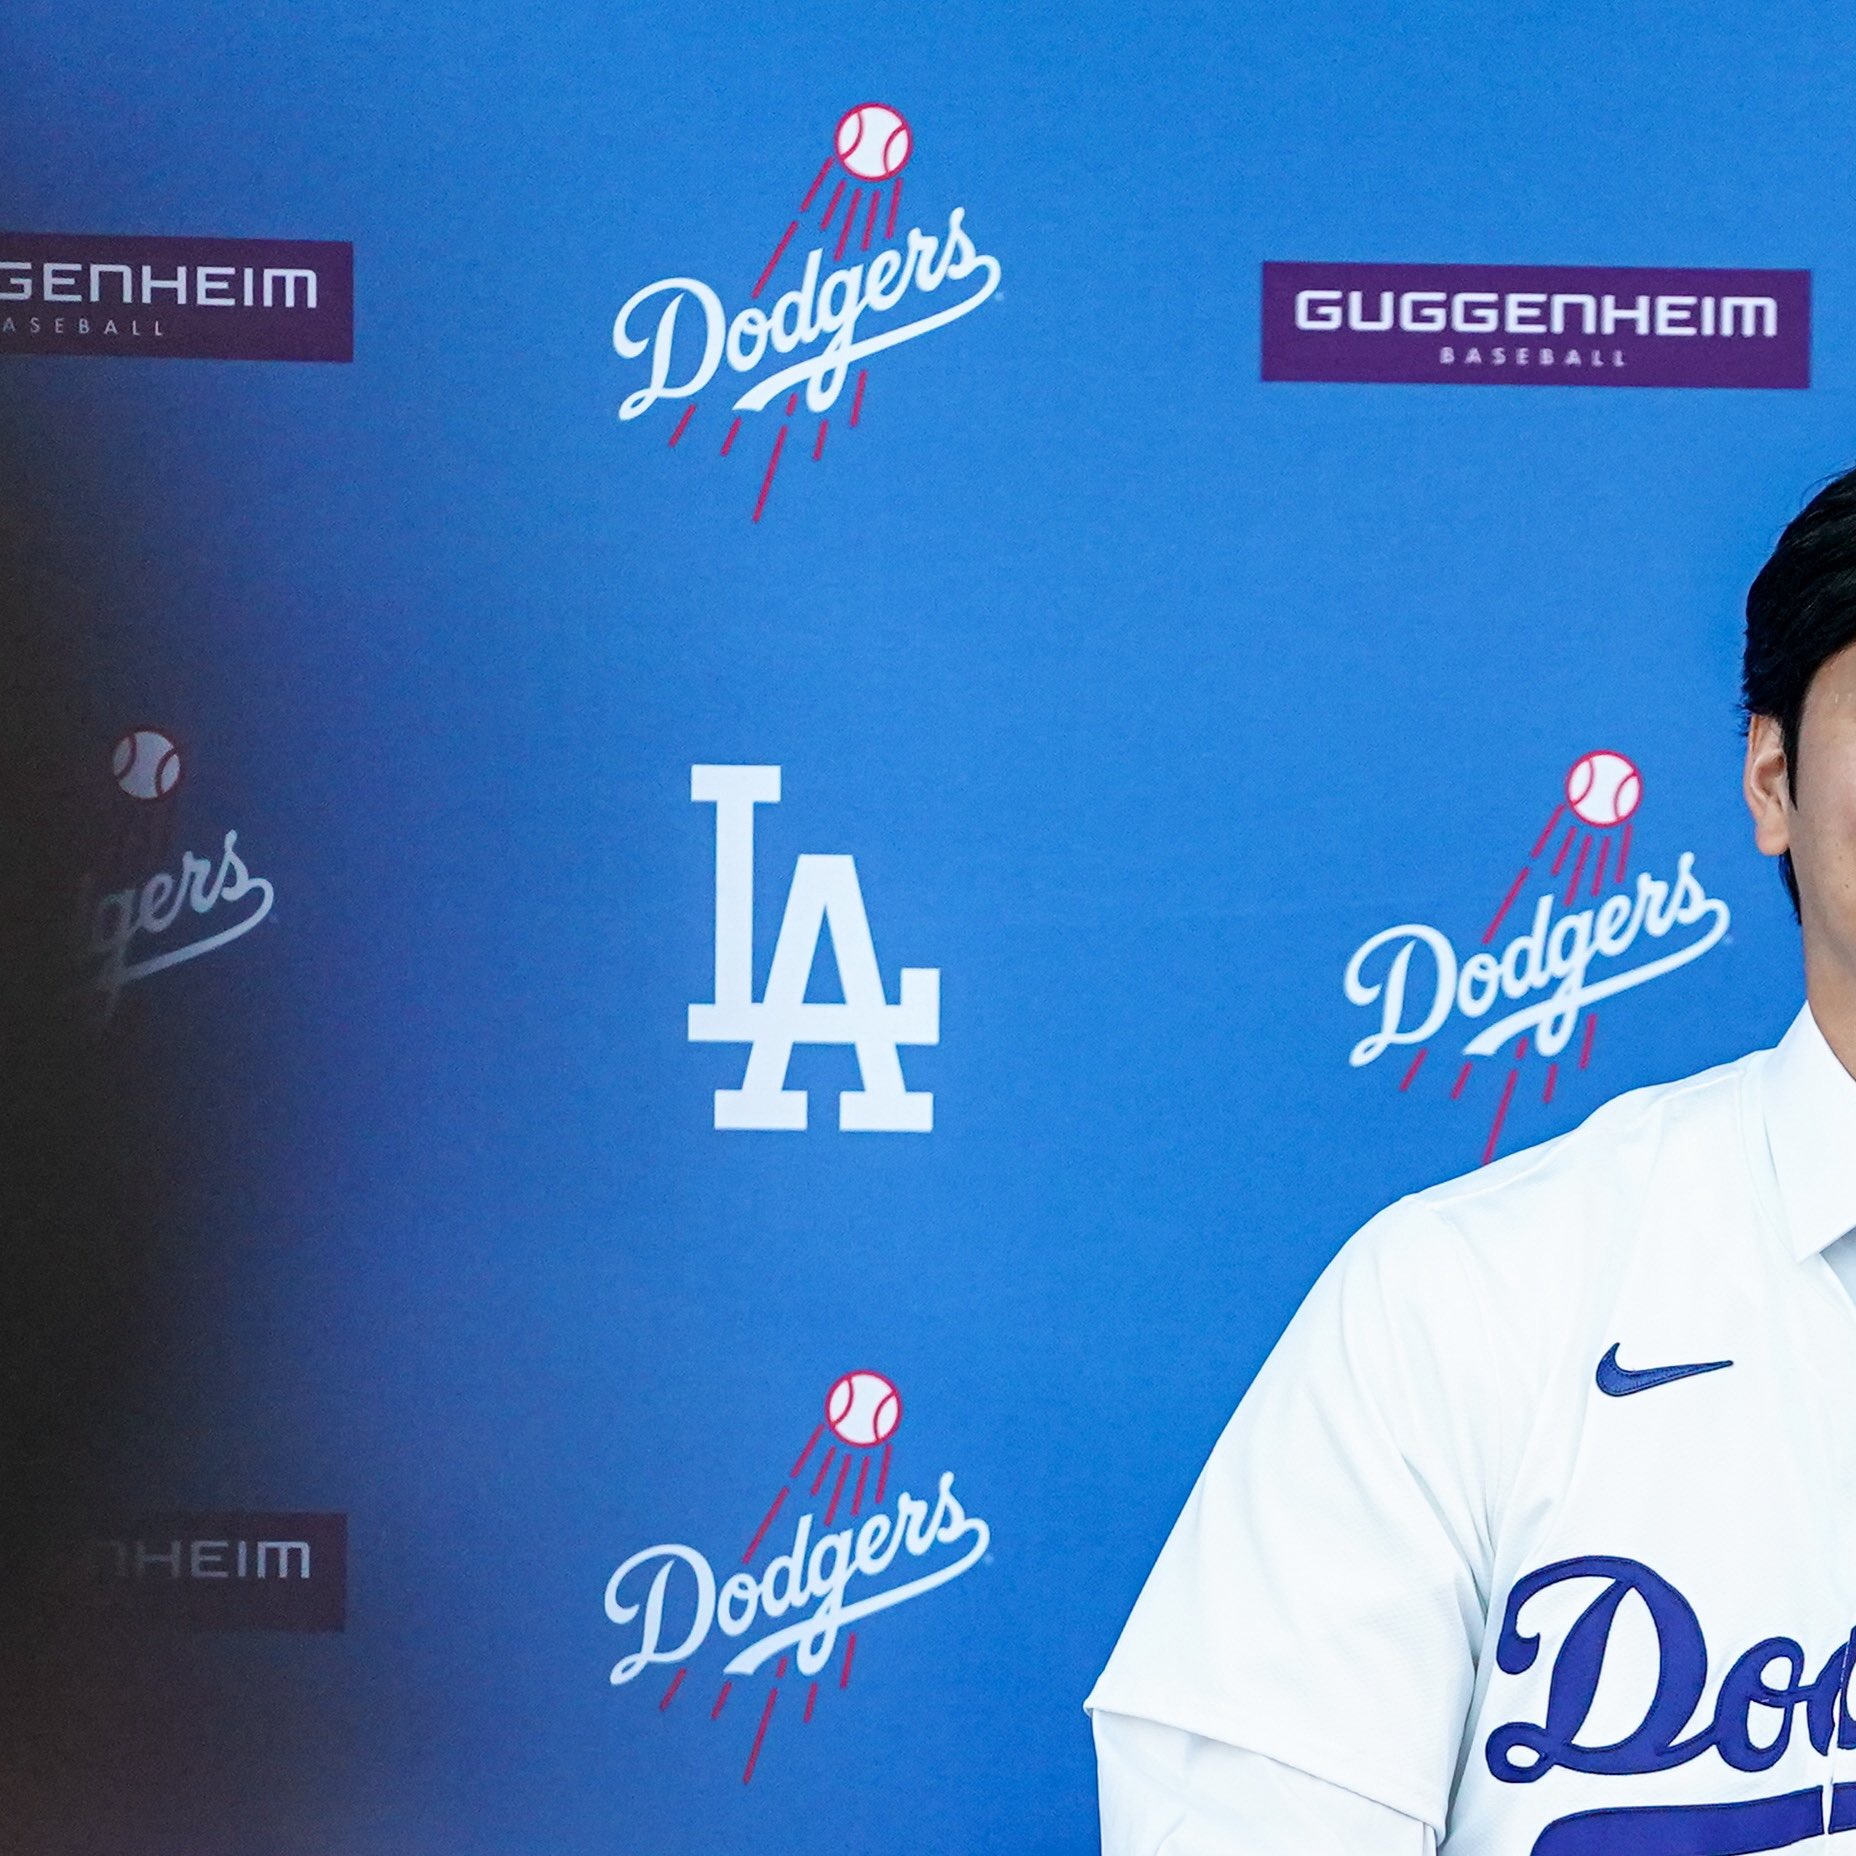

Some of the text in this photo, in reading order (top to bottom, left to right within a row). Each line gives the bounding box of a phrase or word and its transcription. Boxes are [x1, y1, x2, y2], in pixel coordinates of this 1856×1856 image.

[612, 205, 1002, 422] Dodgers
[1295, 289, 1778, 338] GUGGENHEIM
[1439, 346, 1626, 368] BASEBALL
[687, 764, 940, 1132] LA
[1343, 851, 1731, 1068] Dodgers
[604, 1471, 991, 1685] Dodgers
